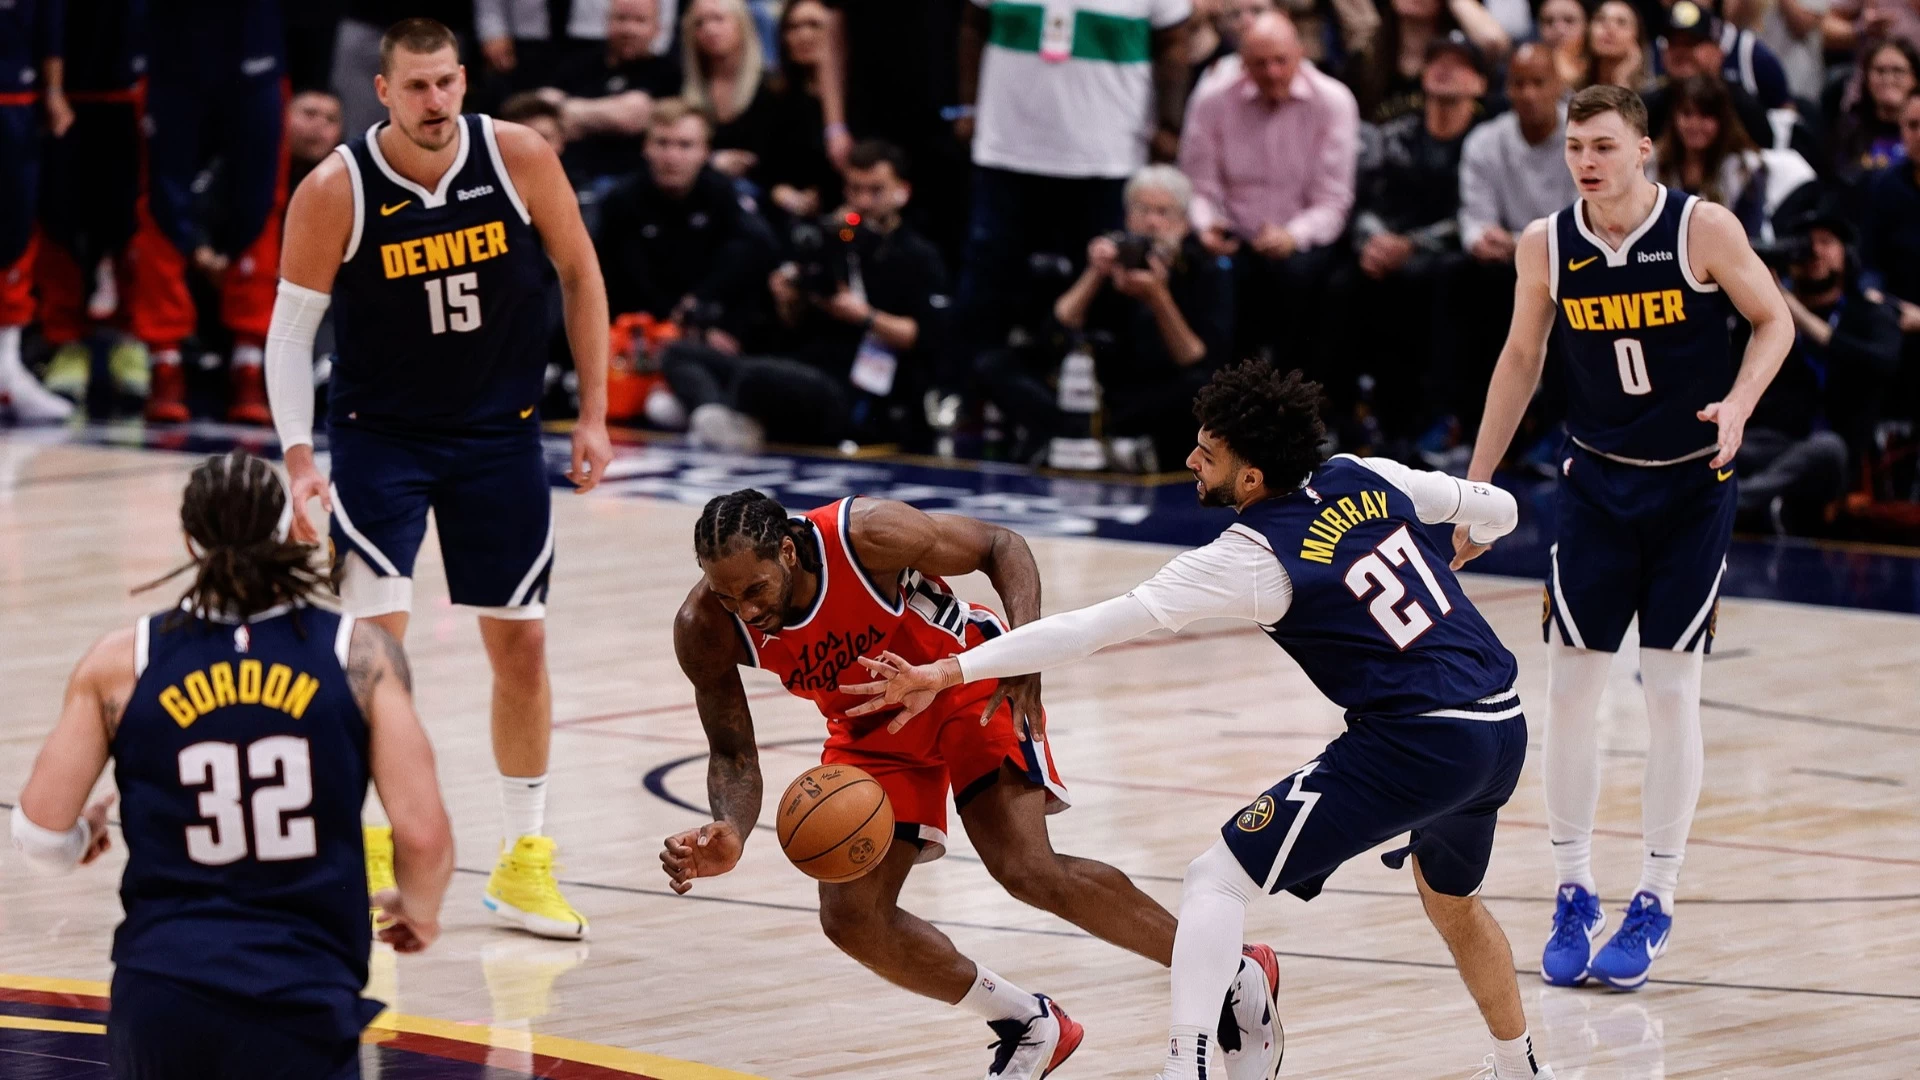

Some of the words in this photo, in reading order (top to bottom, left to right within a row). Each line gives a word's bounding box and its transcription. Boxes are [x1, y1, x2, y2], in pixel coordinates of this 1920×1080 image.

[456, 184, 495, 201] ibotta
[380, 221, 509, 280] DENVER
[1637, 250, 1674, 264] ibotta
[424, 271, 482, 335] 15
[1562, 289, 1687, 331] DENVER
[1613, 337, 1652, 396] 0
[1300, 490, 1389, 565] MURRAY
[1342, 522, 1454, 651] 27
[783, 624, 887, 693] Angeles
[797, 630, 844, 676] Los
[158, 659, 320, 729] GORDON
[177, 735, 318, 866] 32
